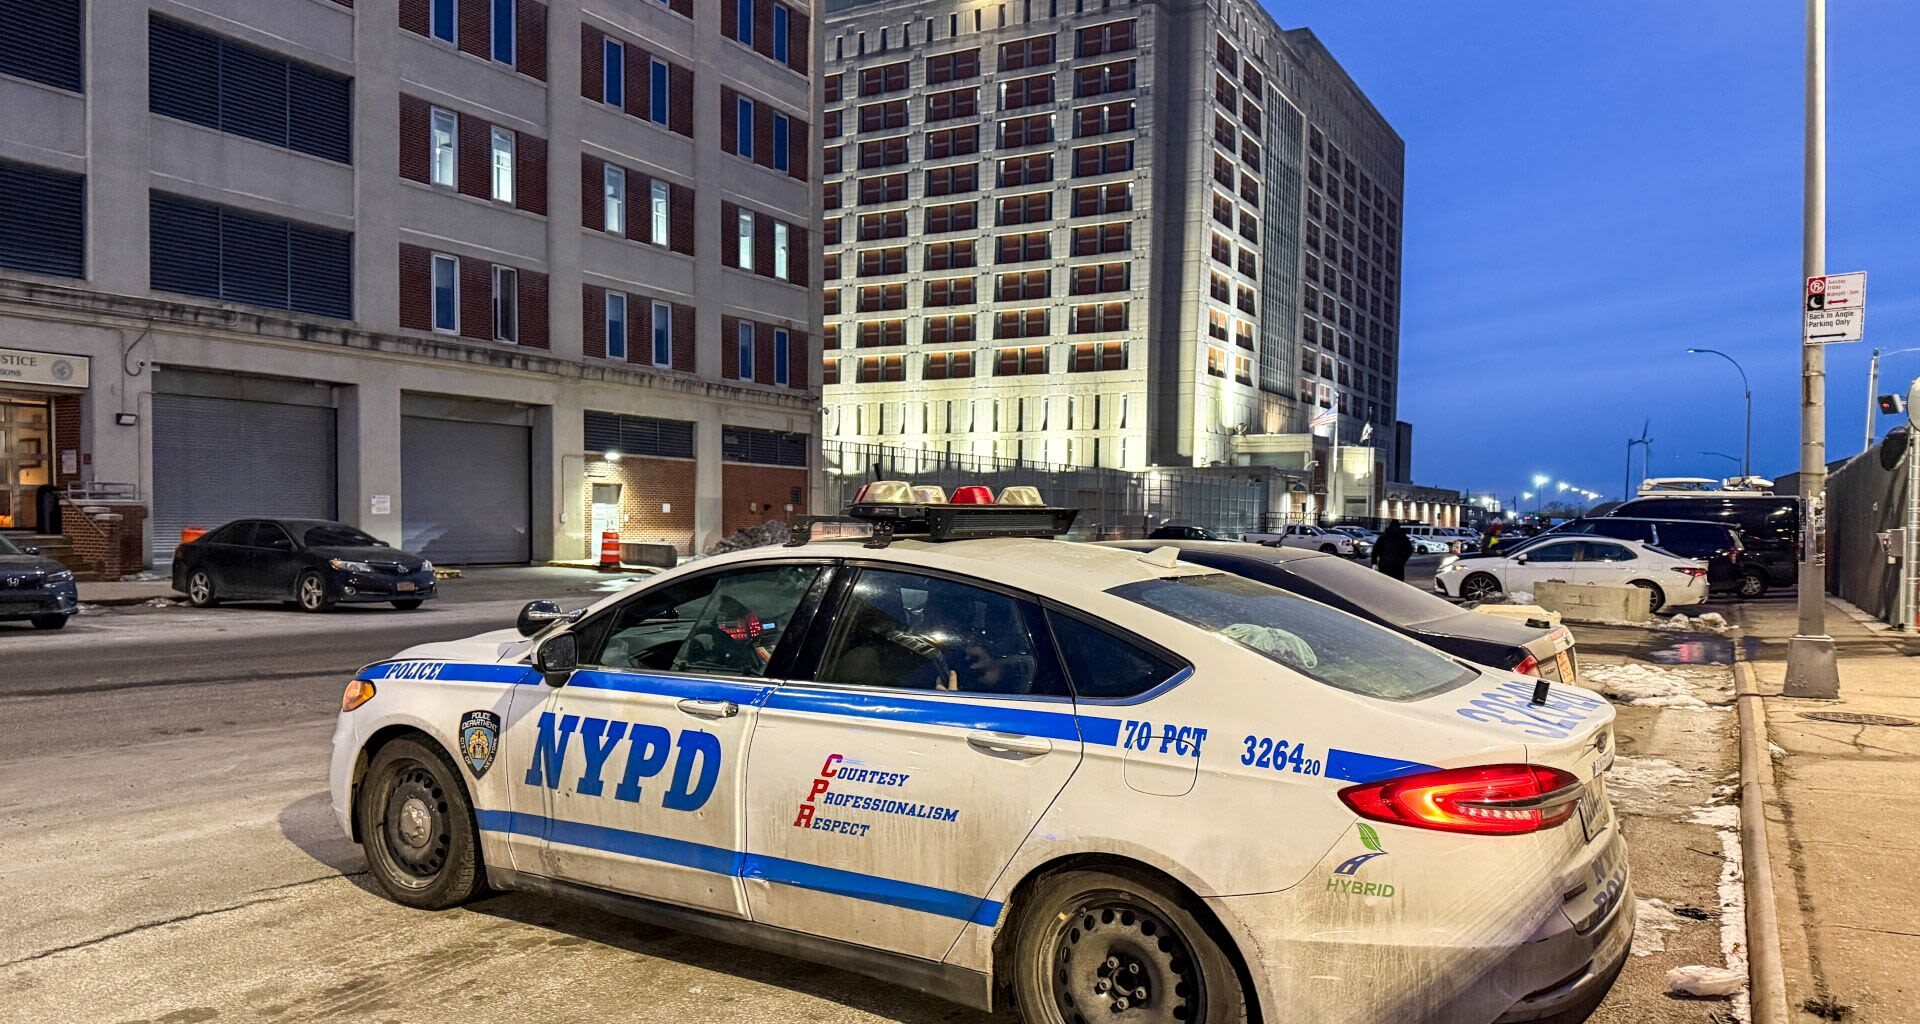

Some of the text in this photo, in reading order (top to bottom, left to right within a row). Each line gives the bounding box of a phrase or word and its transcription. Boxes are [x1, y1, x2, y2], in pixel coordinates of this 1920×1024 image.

[1809, 312, 1824, 320] Back
[1809, 319, 1850, 328] Parking Only
[385, 662, 443, 680] POLICE
[462, 719, 497, 732] DEPARTMENT
[471, 712, 491, 720] POLICE
[1123, 720, 1207, 757] 70 PCT
[484, 755, 493, 770] NEW
[525, 711, 721, 812] NYPD
[821, 753, 910, 787] COURTESY
[806, 779, 959, 823] PROFESSIONALISM
[793, 804, 870, 838] RESPECT
[1326, 878, 1396, 898] HYBRID
